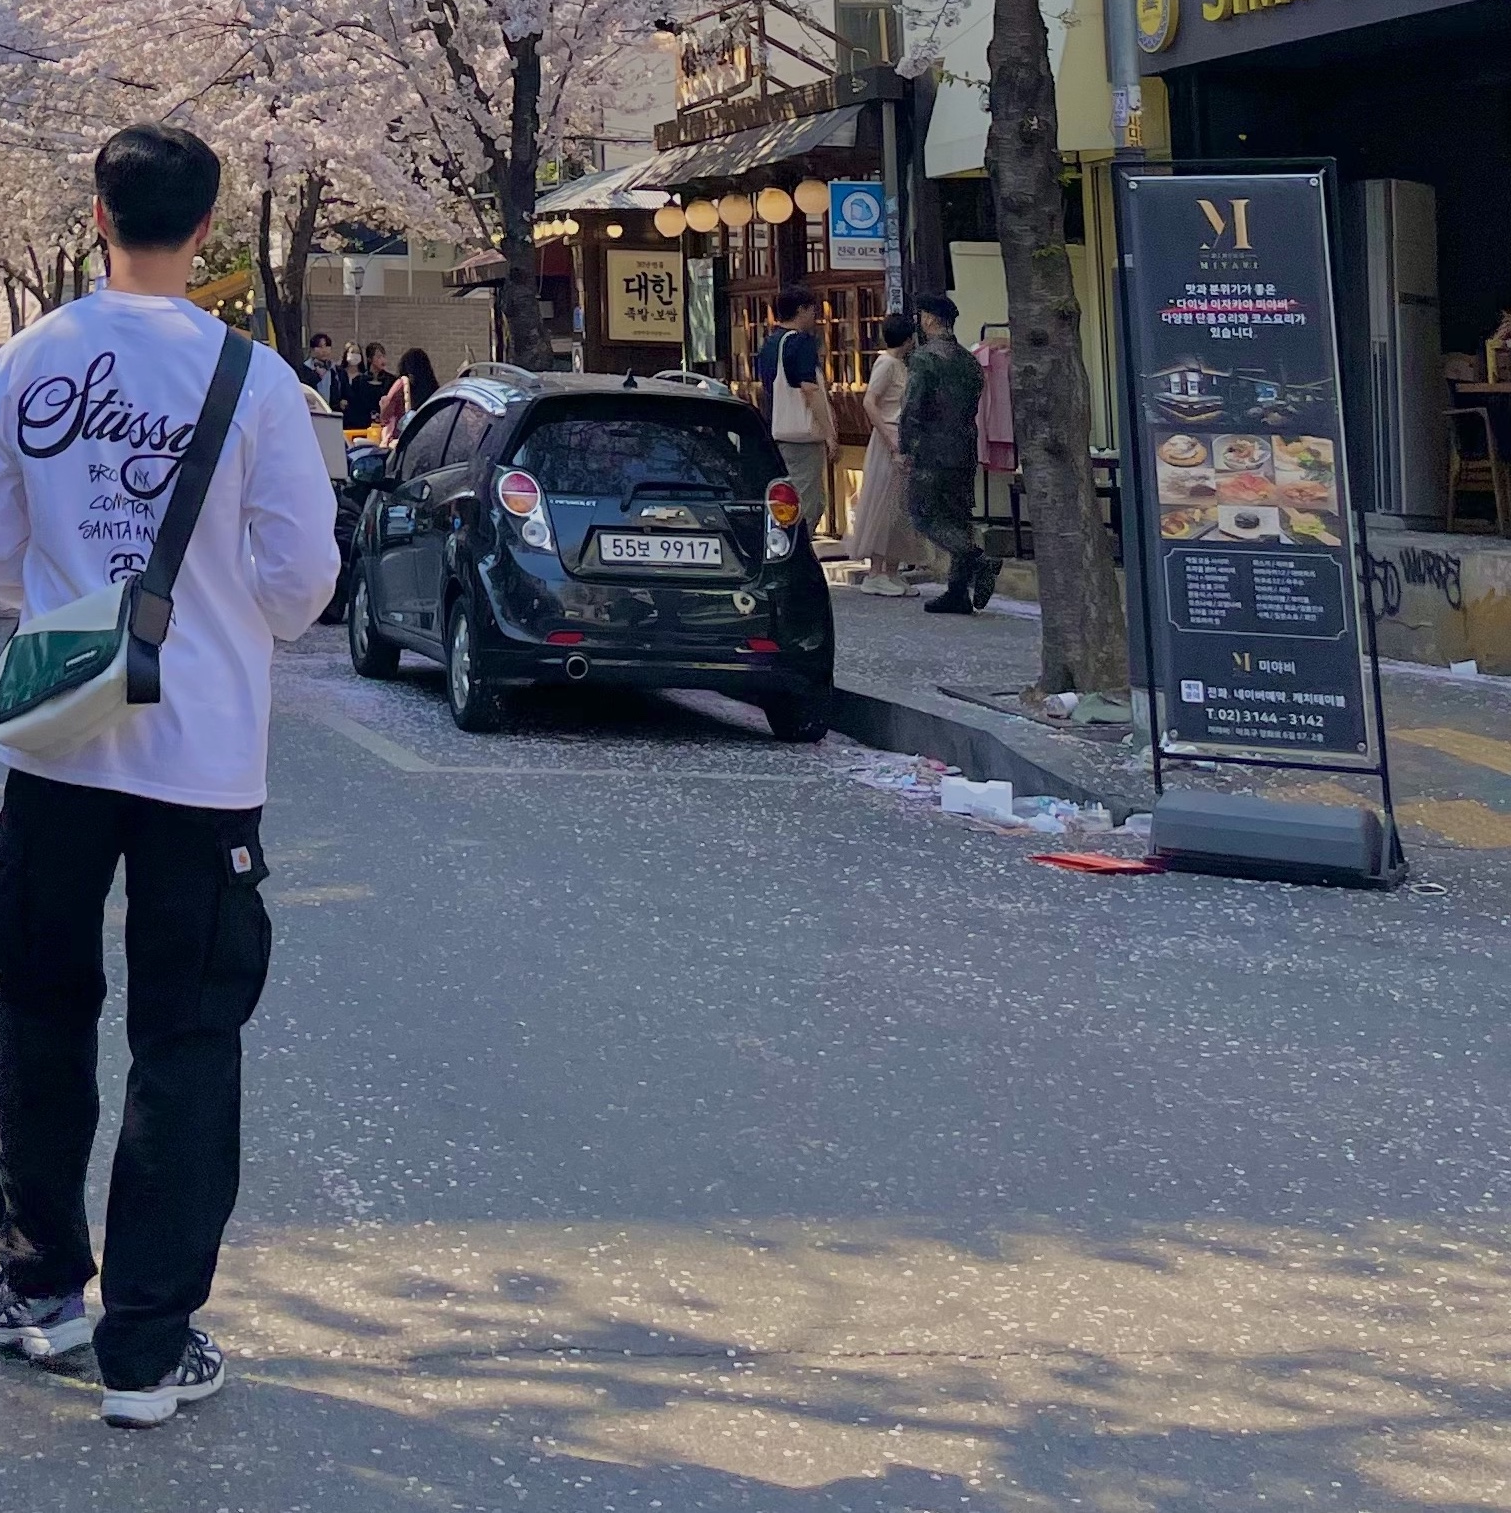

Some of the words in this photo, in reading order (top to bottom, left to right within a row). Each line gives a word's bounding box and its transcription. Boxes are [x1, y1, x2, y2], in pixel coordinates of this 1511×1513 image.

[623, 271, 678, 306] 대한
[17, 351, 198, 500] Stüssy
[90, 492, 156, 520] COMPTON
[135, 523, 156, 546] AN
[612, 538, 650, 558] 55보
[660, 541, 710, 560] 9917
